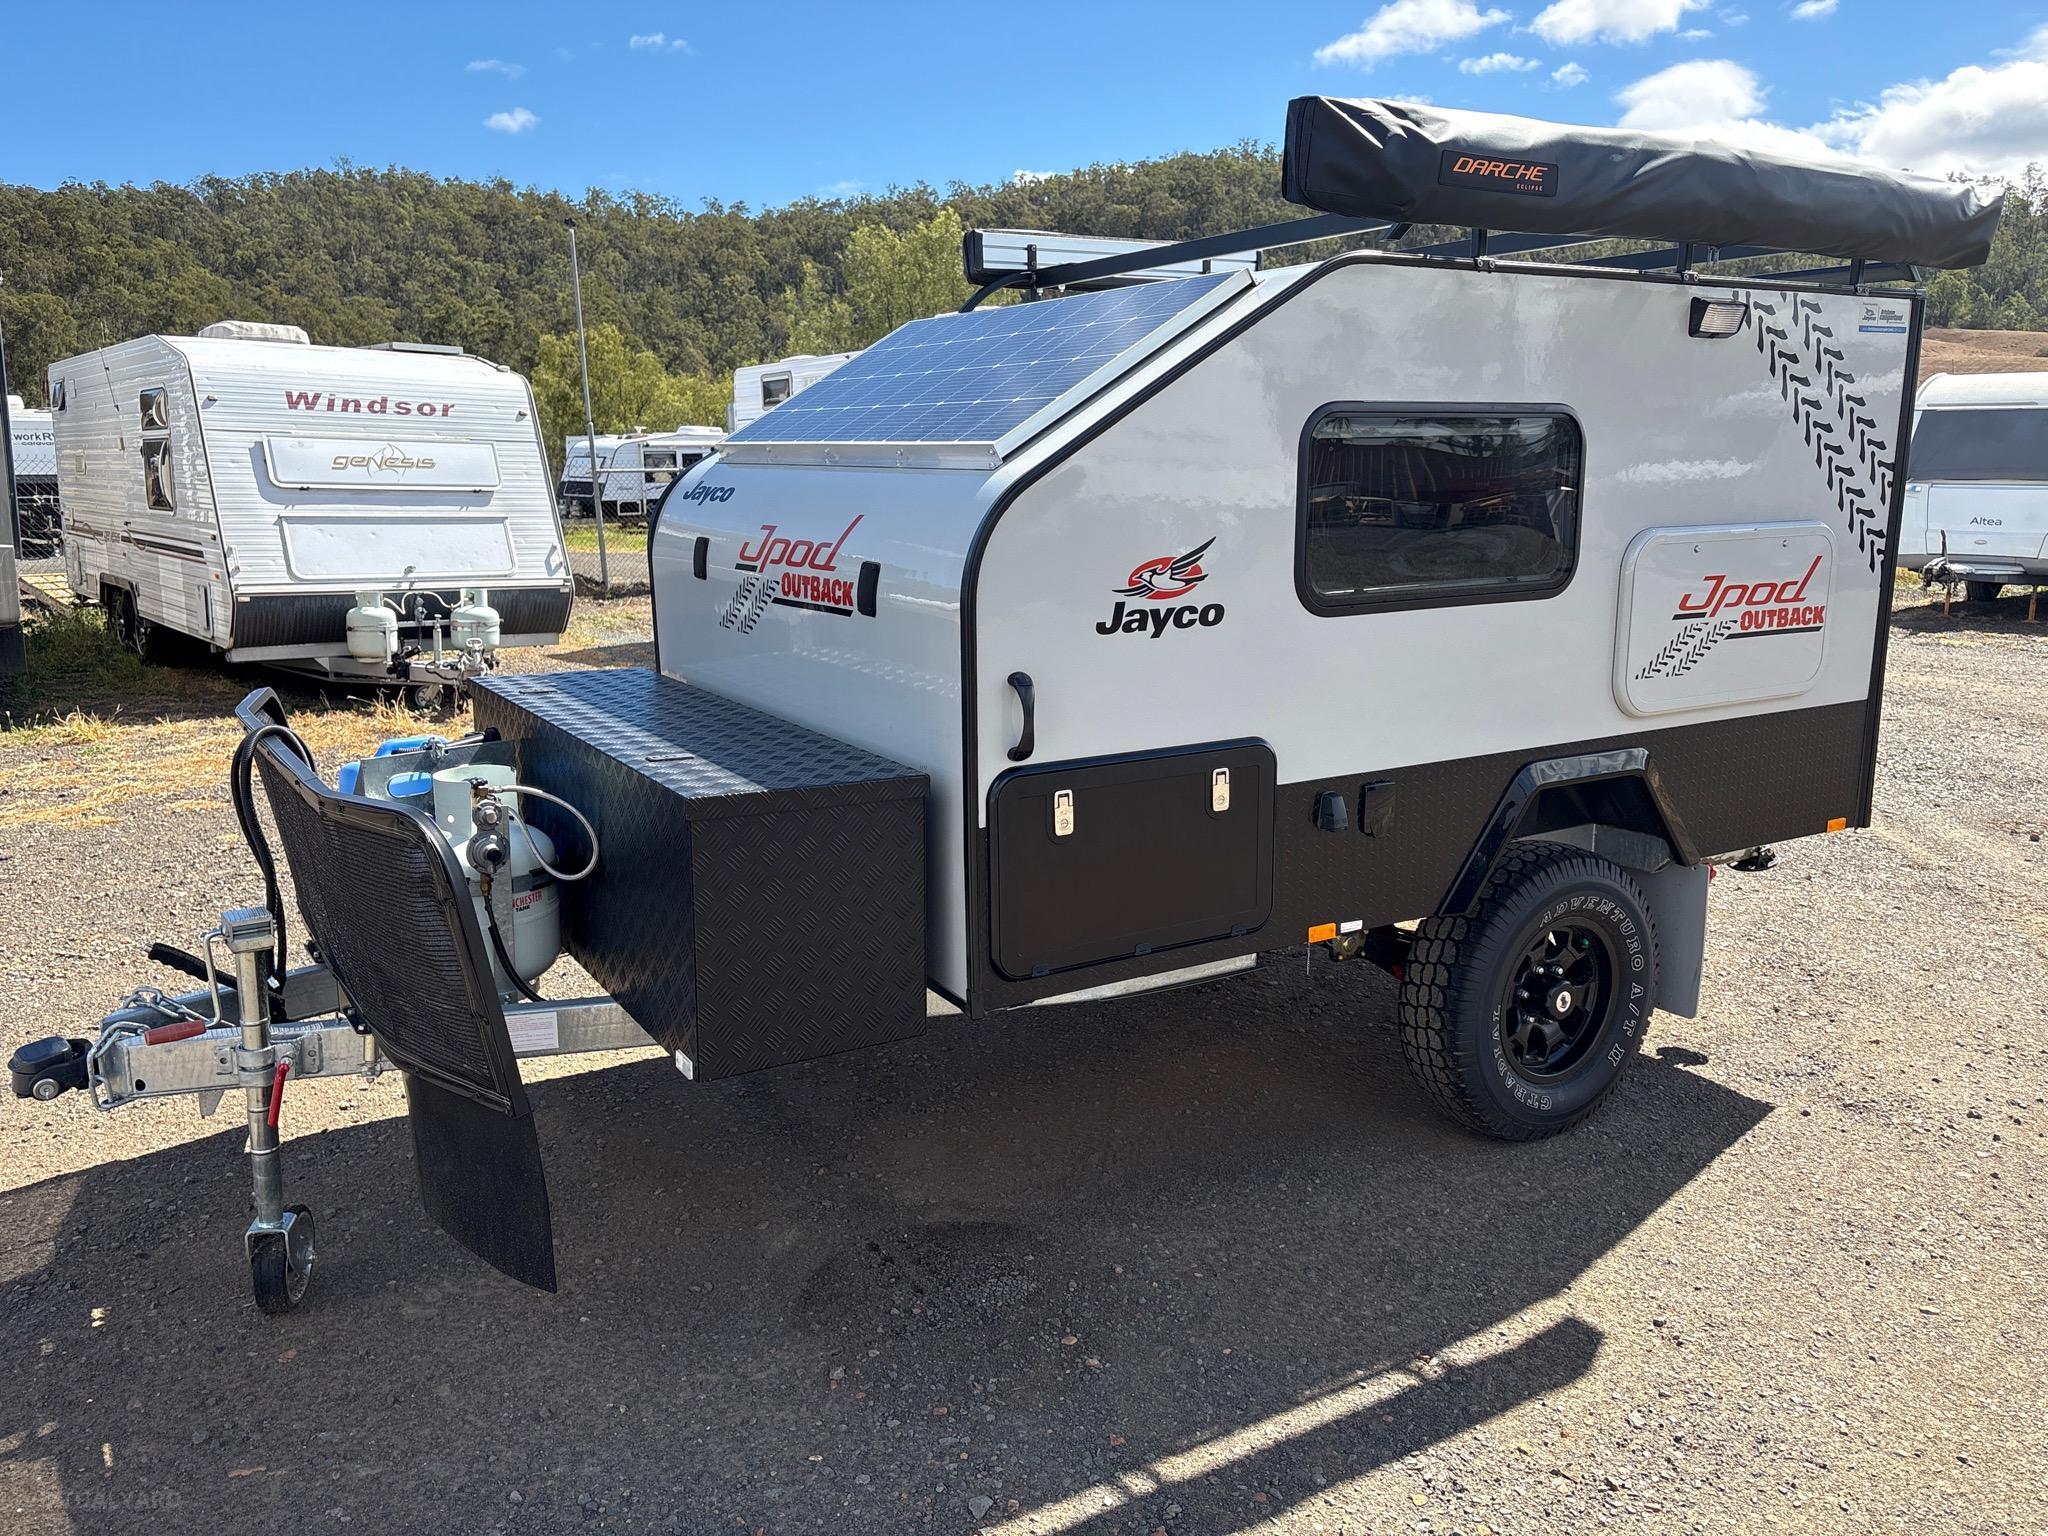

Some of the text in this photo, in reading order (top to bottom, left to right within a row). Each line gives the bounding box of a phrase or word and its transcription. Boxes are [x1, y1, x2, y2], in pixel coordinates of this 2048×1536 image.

[1452, 156, 1548, 182] DARCHE
[1516, 183, 1543, 192] ECLIPSE
[285, 390, 456, 417] Windsor
[12, 432, 55, 441] workR
[331, 454, 436, 471] genesis
[683, 480, 736, 506] Jayco
[1969, 516, 2002, 526] Altea
[738, 514, 865, 573] Jpod
[780, 571, 854, 607] OUTBACK
[1678, 555, 1824, 618] Jpod
[1095, 601, 1225, 639] Jayco
[1739, 605, 1826, 632] OUTBACK
[1539, 896, 1645, 972] ADVENTURO
[1623, 982, 1644, 1038] A/T
